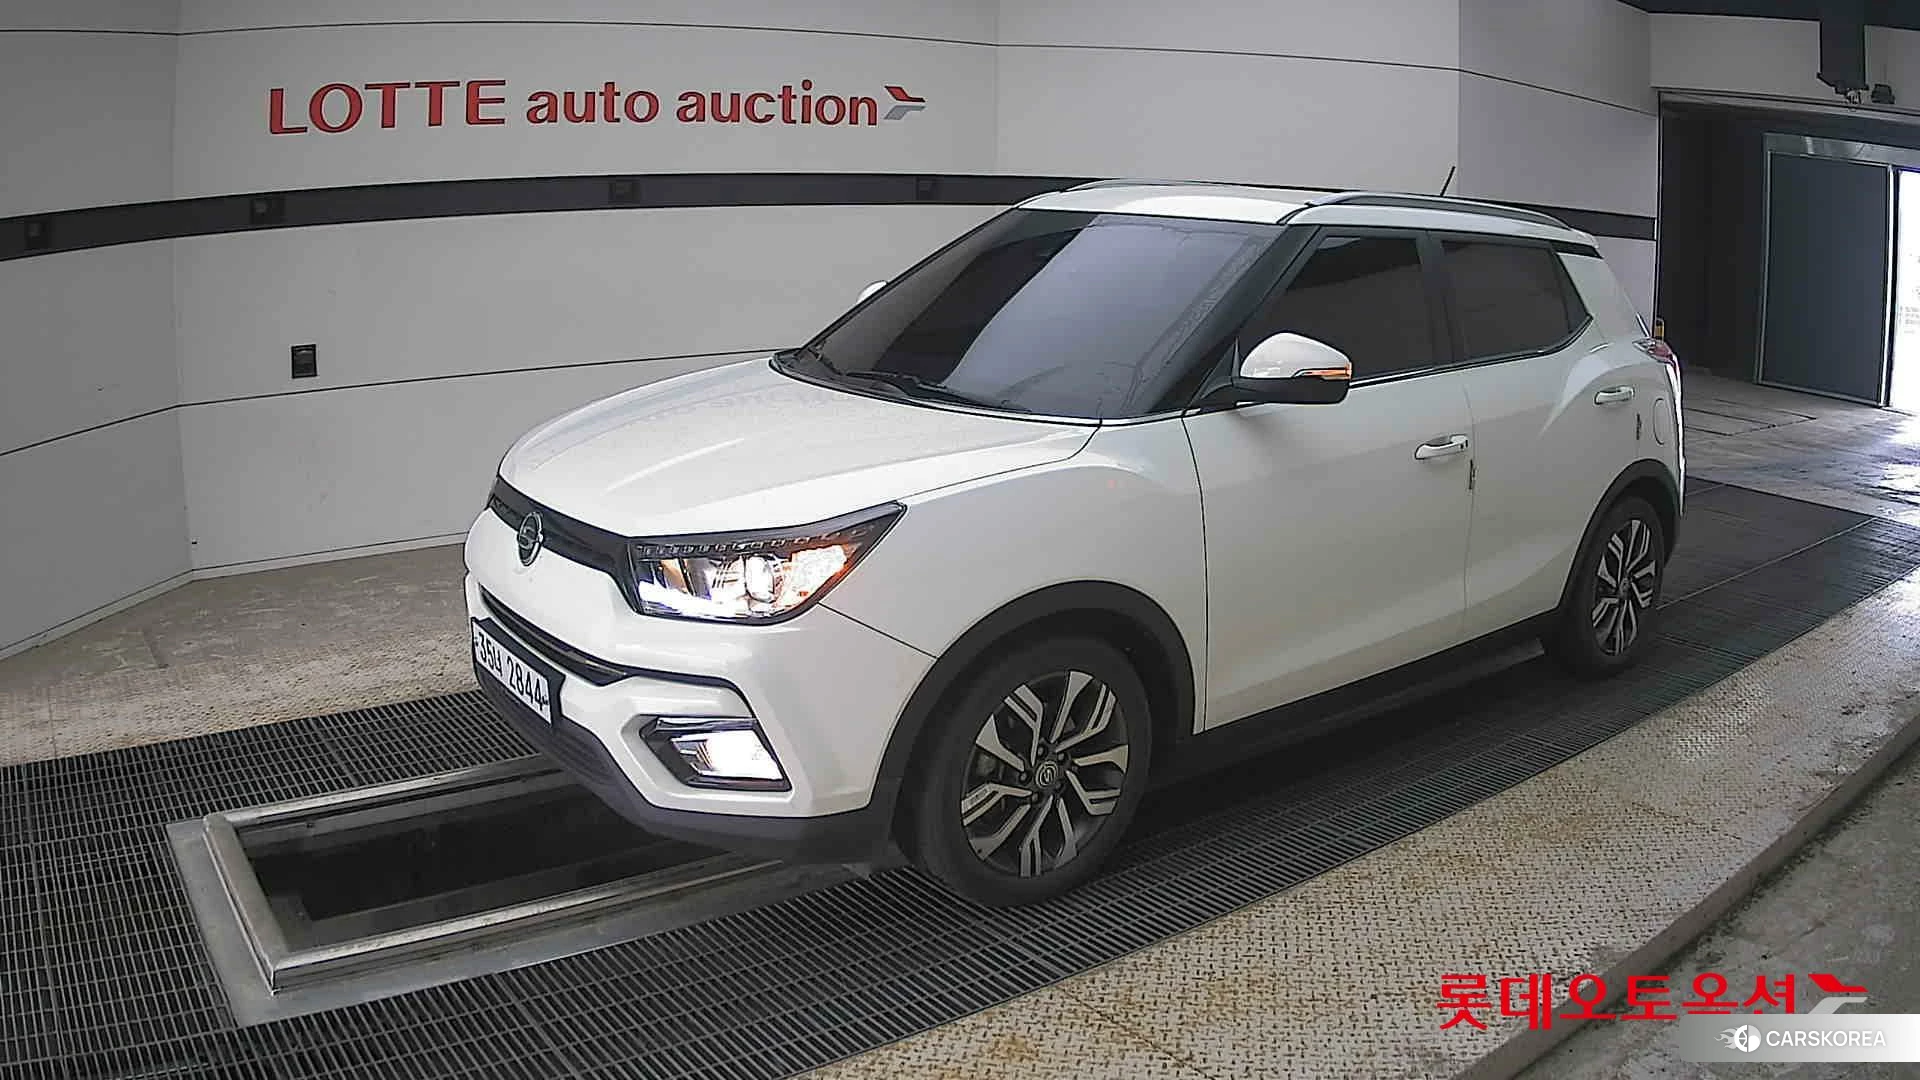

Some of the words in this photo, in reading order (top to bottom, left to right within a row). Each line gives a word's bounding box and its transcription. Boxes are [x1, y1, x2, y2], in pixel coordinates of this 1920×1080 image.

[270, 80, 506, 134] LOTTE
[527, 82, 660, 124] auto
[677, 79, 878, 126] auction
[507, 655, 543, 711] 2844
